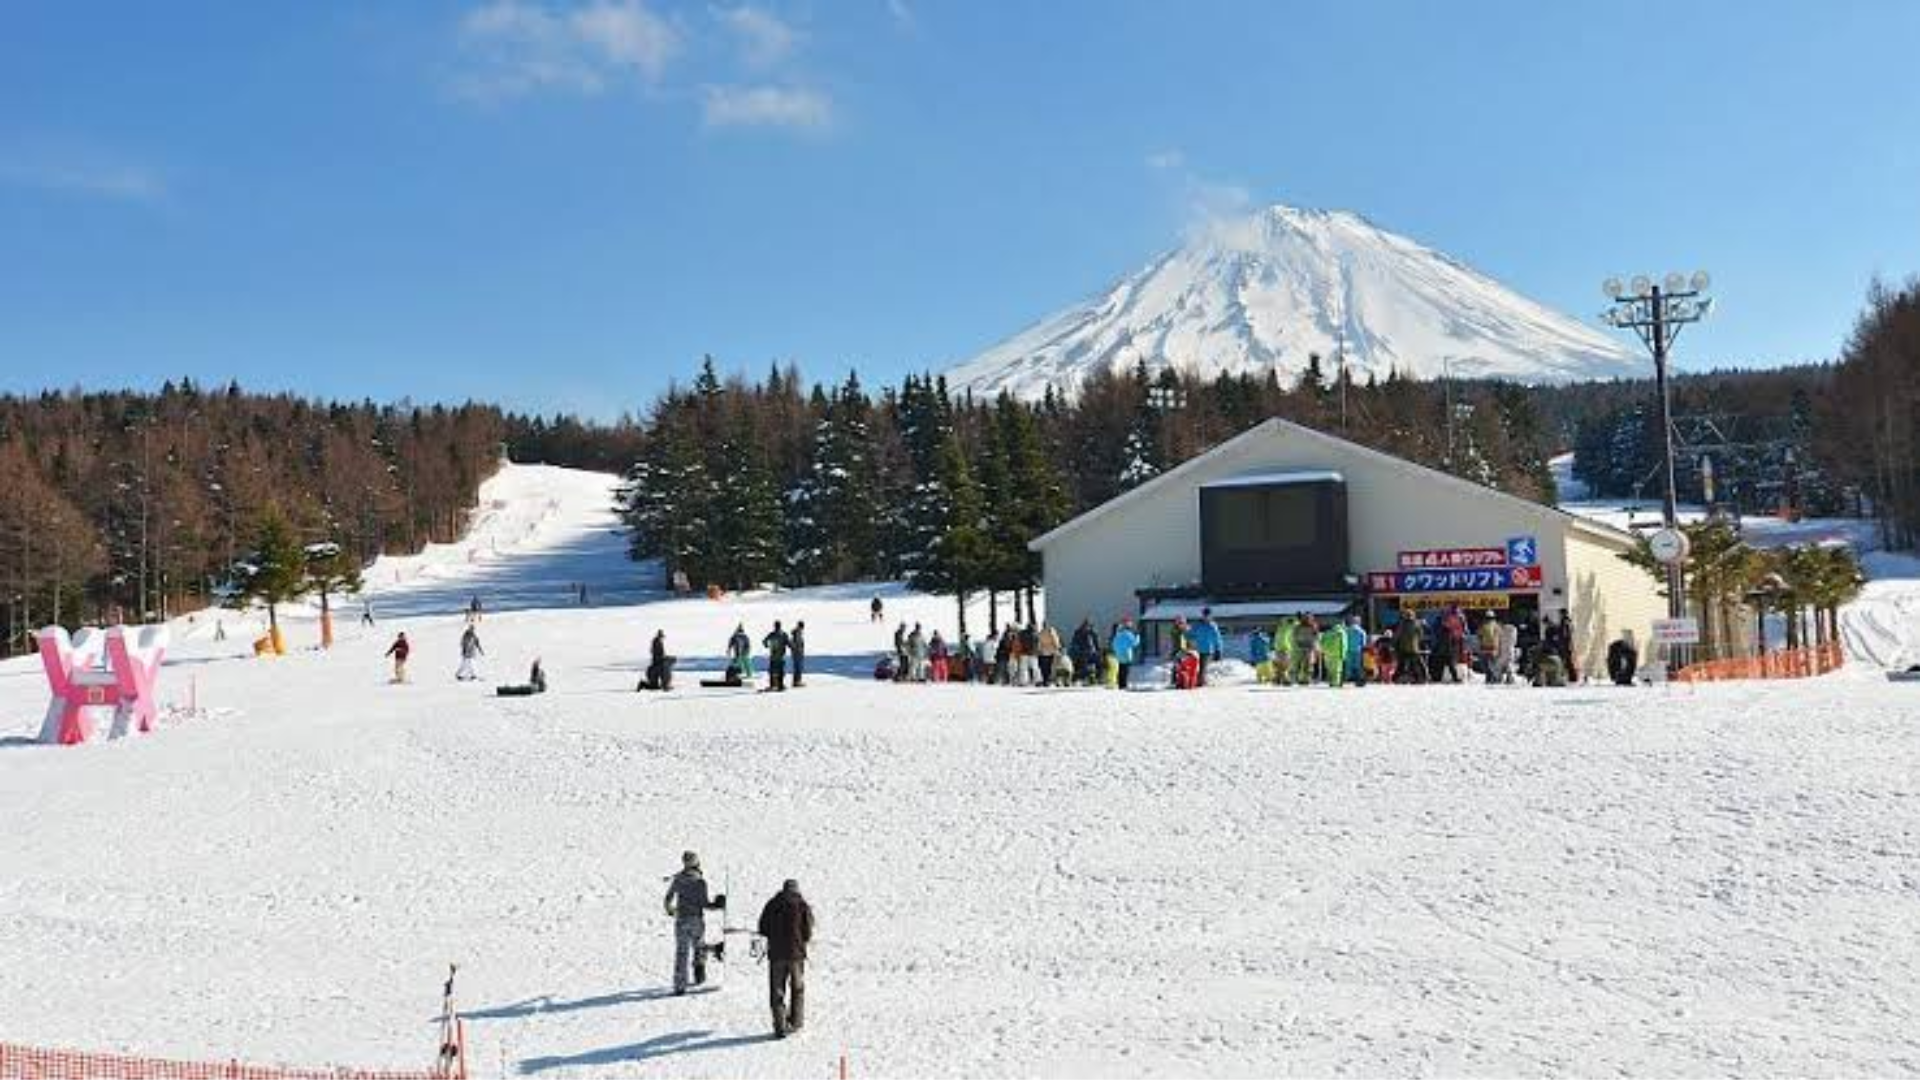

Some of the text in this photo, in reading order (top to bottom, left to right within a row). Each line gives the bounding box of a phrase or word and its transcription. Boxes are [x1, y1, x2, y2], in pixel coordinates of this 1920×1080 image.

[1404, 571, 1505, 589] クワッドリフト
